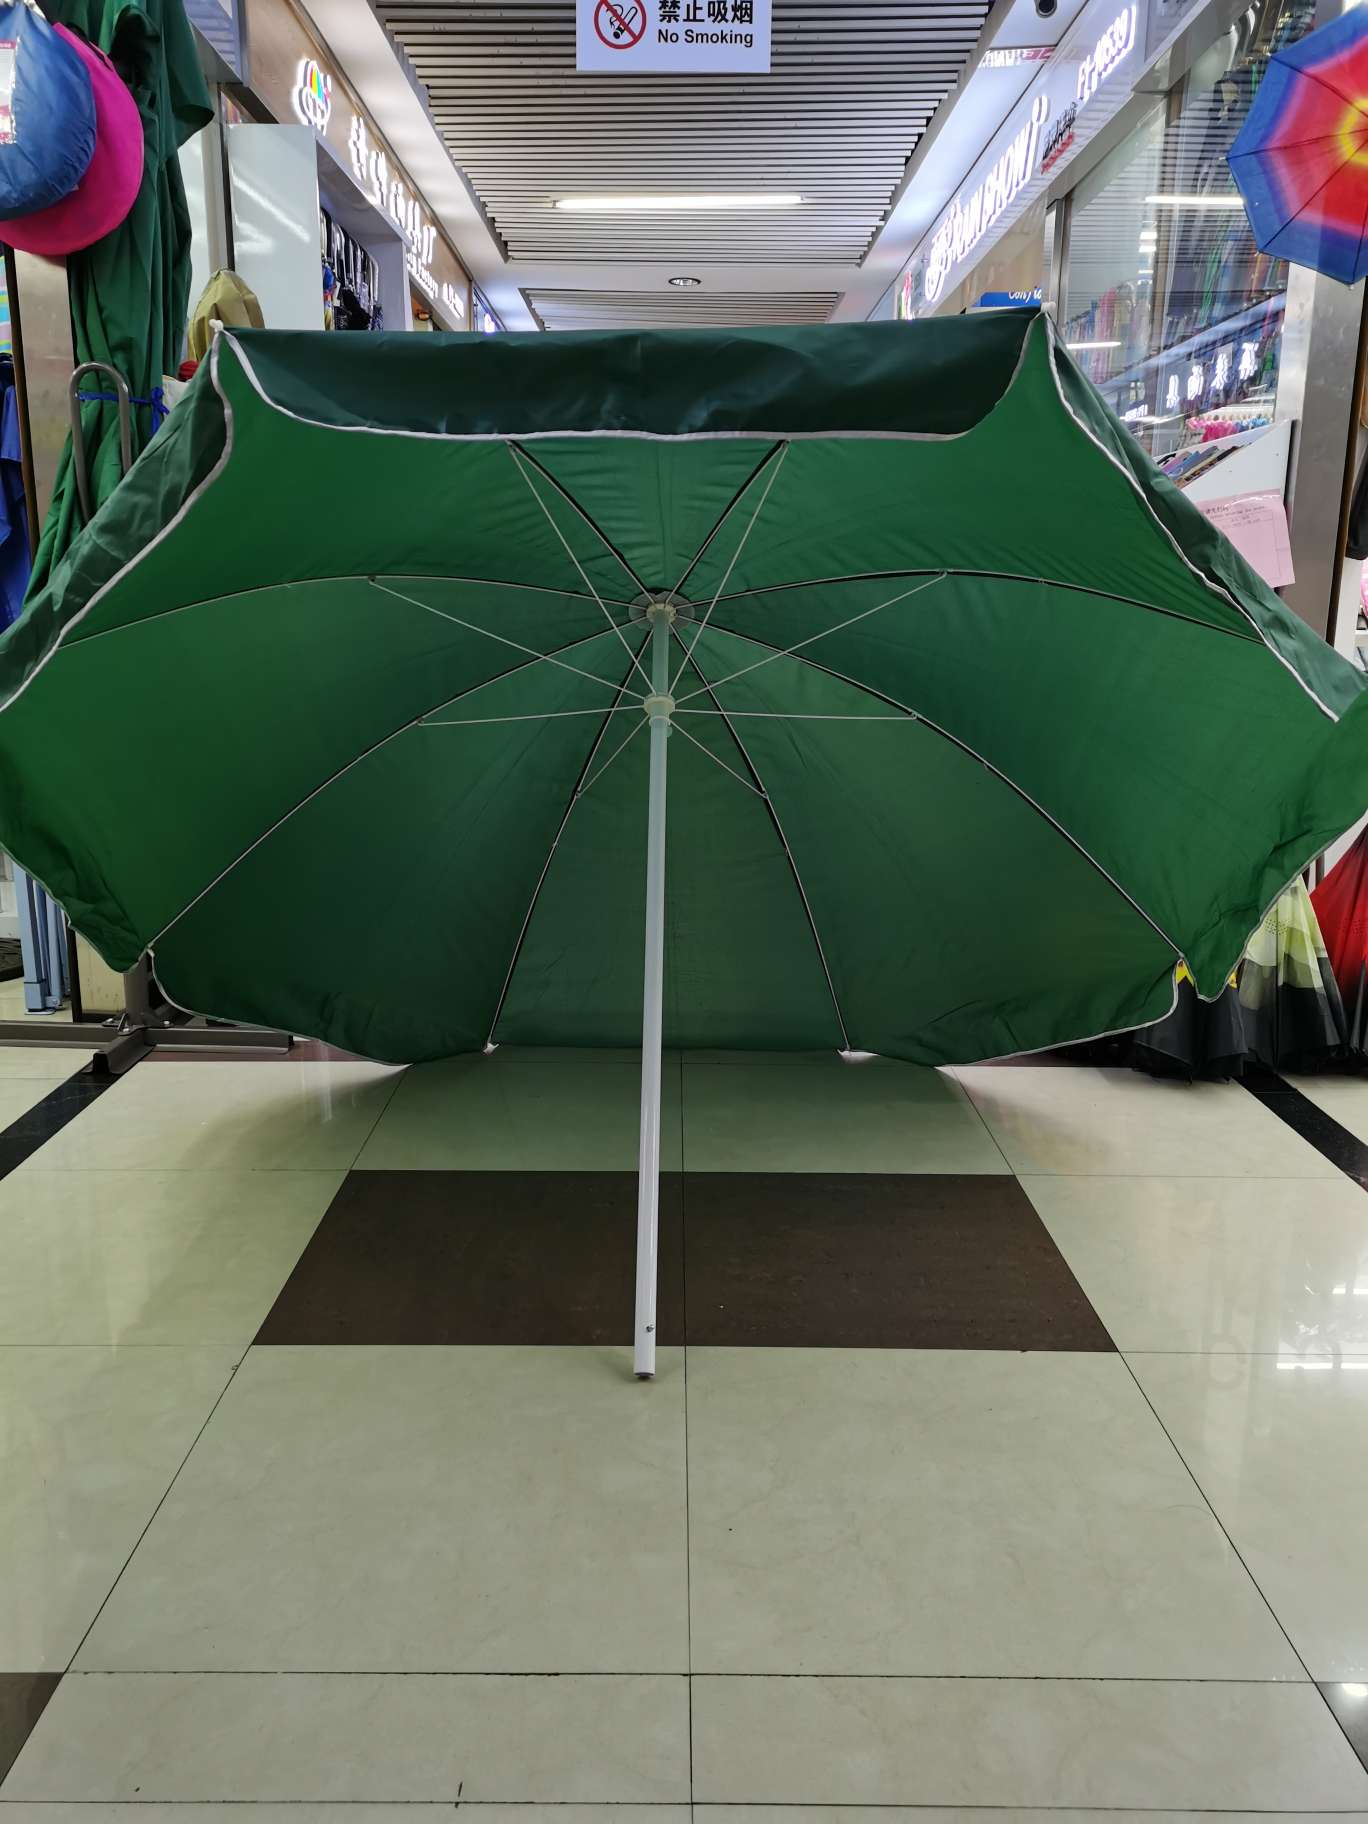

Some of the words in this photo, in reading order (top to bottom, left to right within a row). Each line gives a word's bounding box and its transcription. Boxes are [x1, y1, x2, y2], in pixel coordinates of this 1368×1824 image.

[658, 0, 754, 24] 禁止吸烟
[658, 29, 679, 44] No
[684, 30, 754, 48] Smoking
